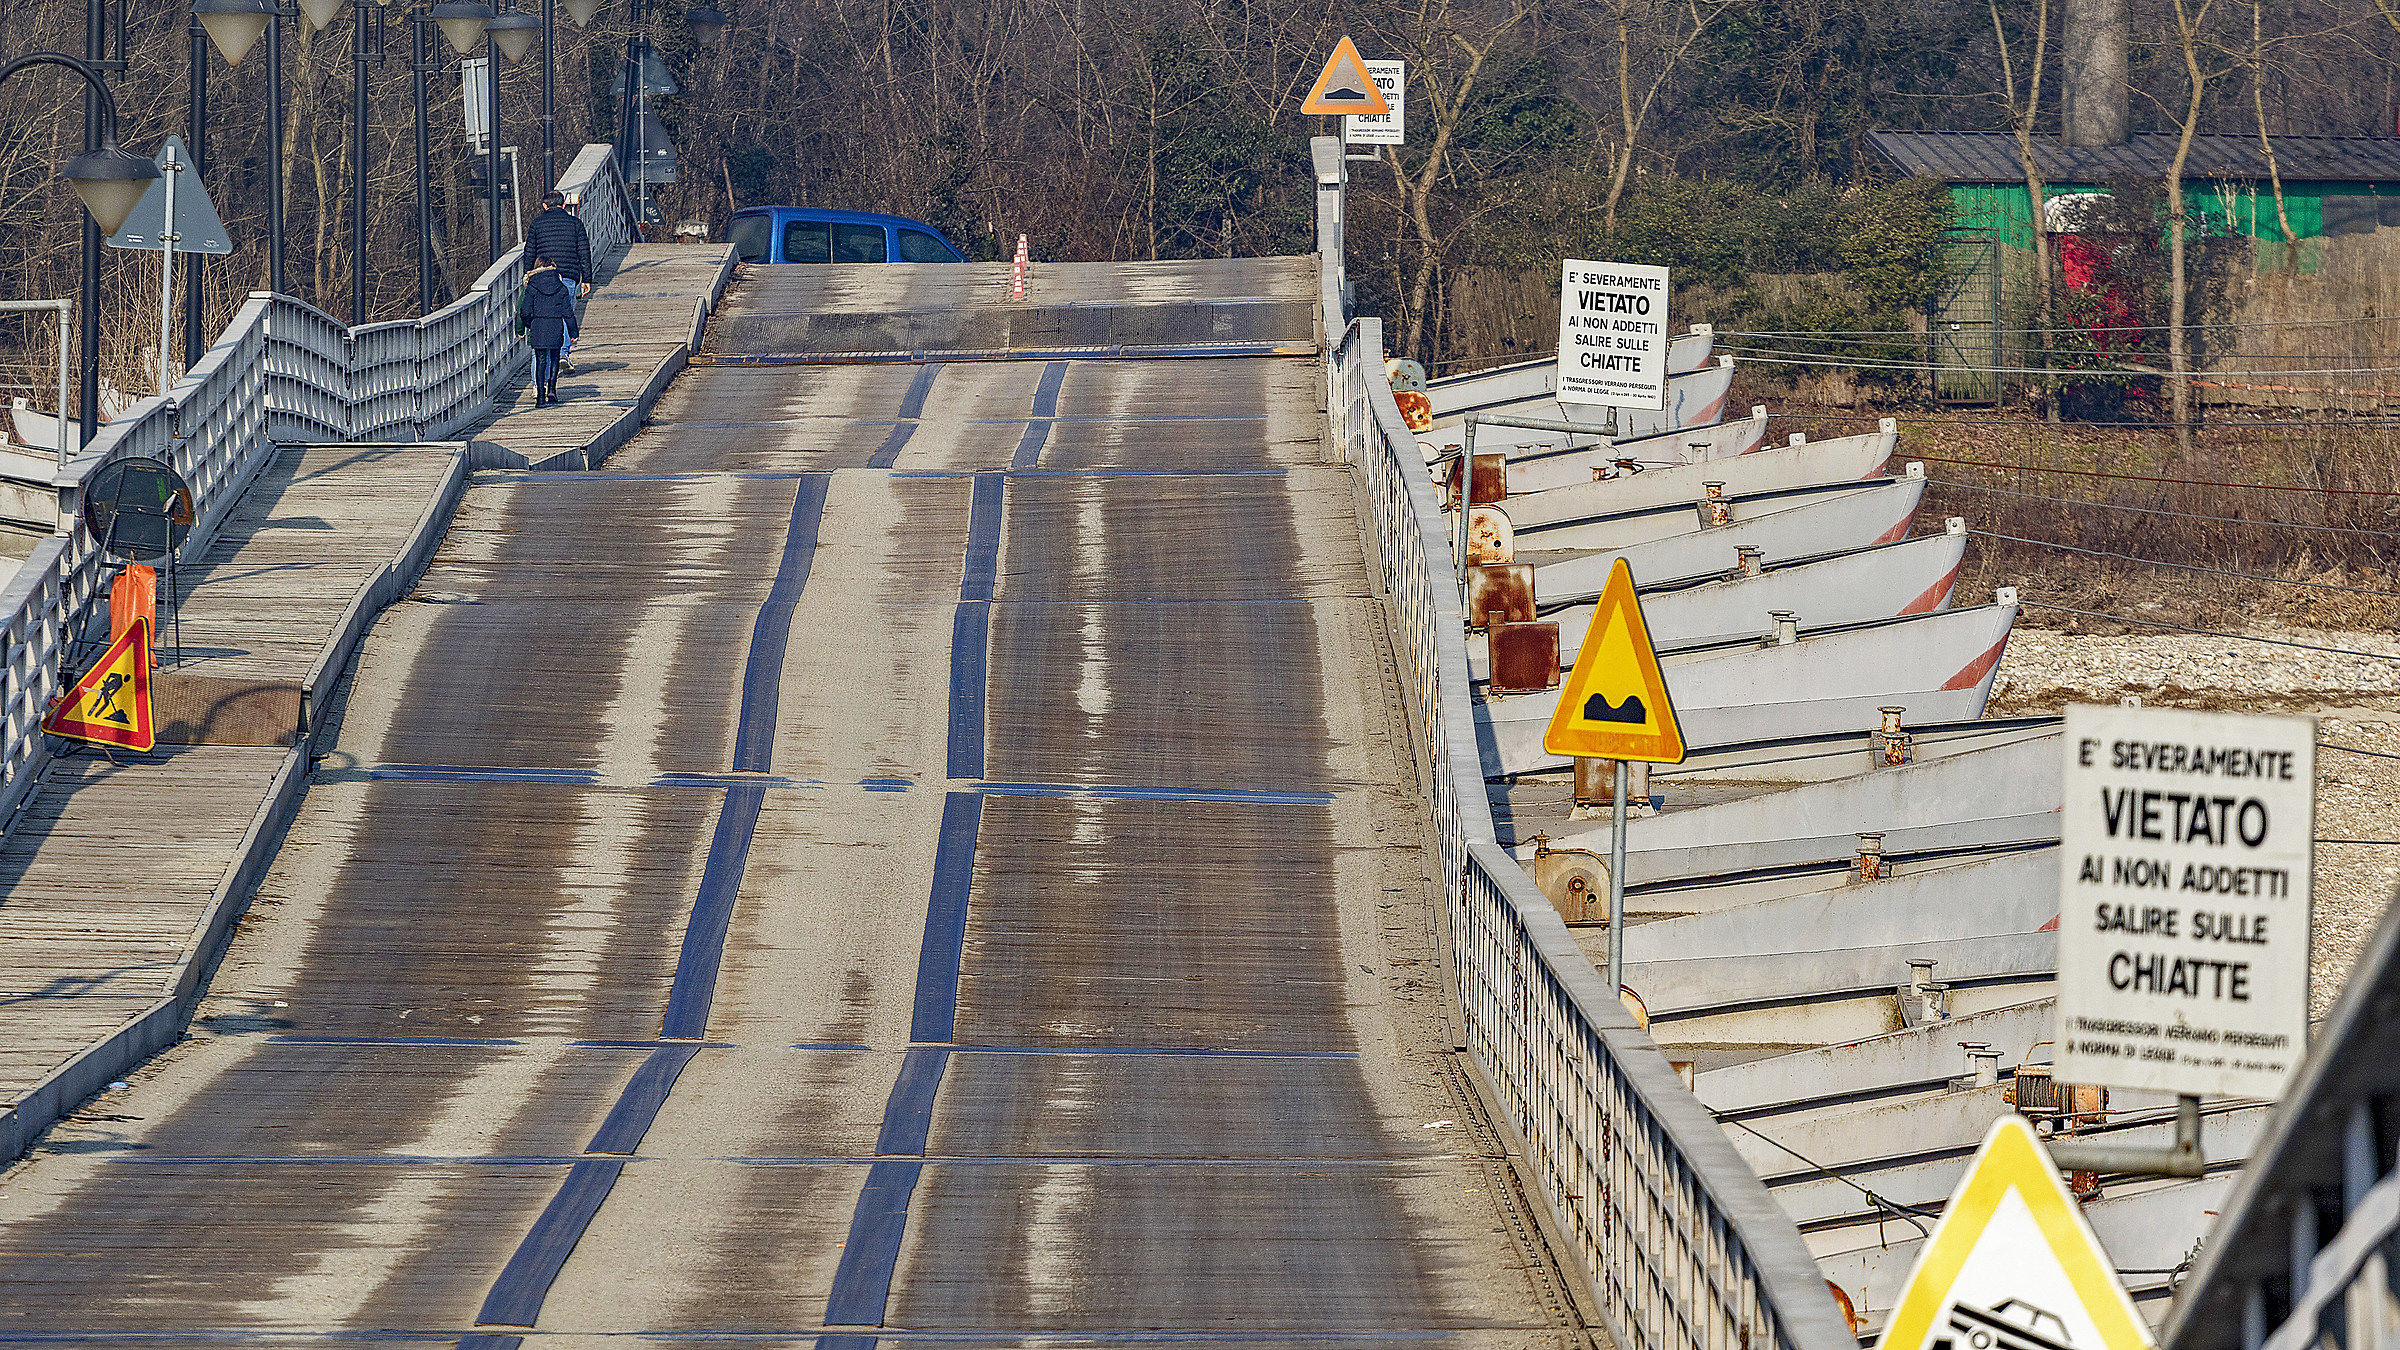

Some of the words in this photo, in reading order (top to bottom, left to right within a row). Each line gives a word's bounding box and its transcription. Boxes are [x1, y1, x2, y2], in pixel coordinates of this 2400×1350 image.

[1359, 114, 1391, 122] CHIATTE
[1569, 272, 1579, 282] E'
[1583, 273, 1660, 290] SEVERAMENTE
[1579, 291, 1650, 315] VIETATO
[1569, 316, 1579, 327] AI
[1584, 317, 1608, 329] NON
[1612, 320, 1658, 334] ADDETTI
[1575, 334, 1611, 347] SALIRE
[1617, 338, 1649, 351] SULLE
[1581, 353, 1641, 372] CHIATTE
[1566, 377, 1603, 385] TRASGRESSORI
[2079, 738, 2102, 768] E'
[2112, 740, 2295, 780] SEVERAMENTE
[2102, 786, 2268, 847] VIETATO
[2079, 855, 2102, 884] AI
[2113, 858, 2170, 889] NON
[2181, 864, 2288, 899] ADDETTI
[2095, 903, 2177, 937] SALIRE
[2192, 912, 2268, 945] SULLE
[2109, 953, 2249, 1001] CHIATTE
